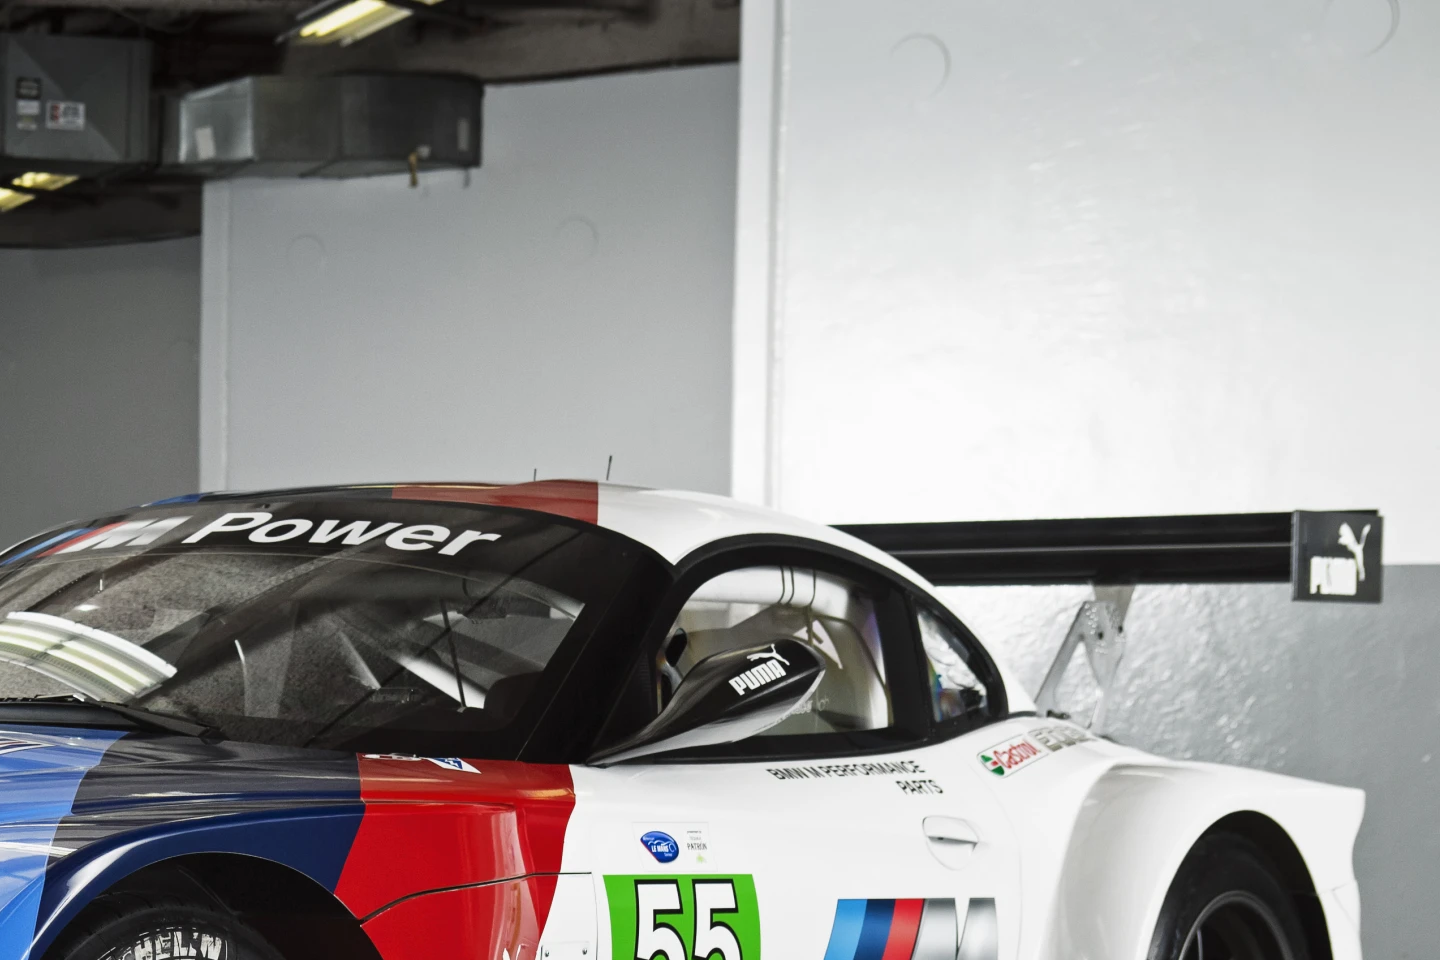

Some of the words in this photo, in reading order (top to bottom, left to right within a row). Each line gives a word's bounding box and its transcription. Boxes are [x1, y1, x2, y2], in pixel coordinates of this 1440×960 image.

[182, 512, 502, 556] Power
[728, 659, 786, 696] PUMA
[765, 766, 810, 780] BMW
[803, 765, 826, 779] M
[818, 761, 926, 777] PERFORMANCE
[895, 780, 944, 795] PARTS
